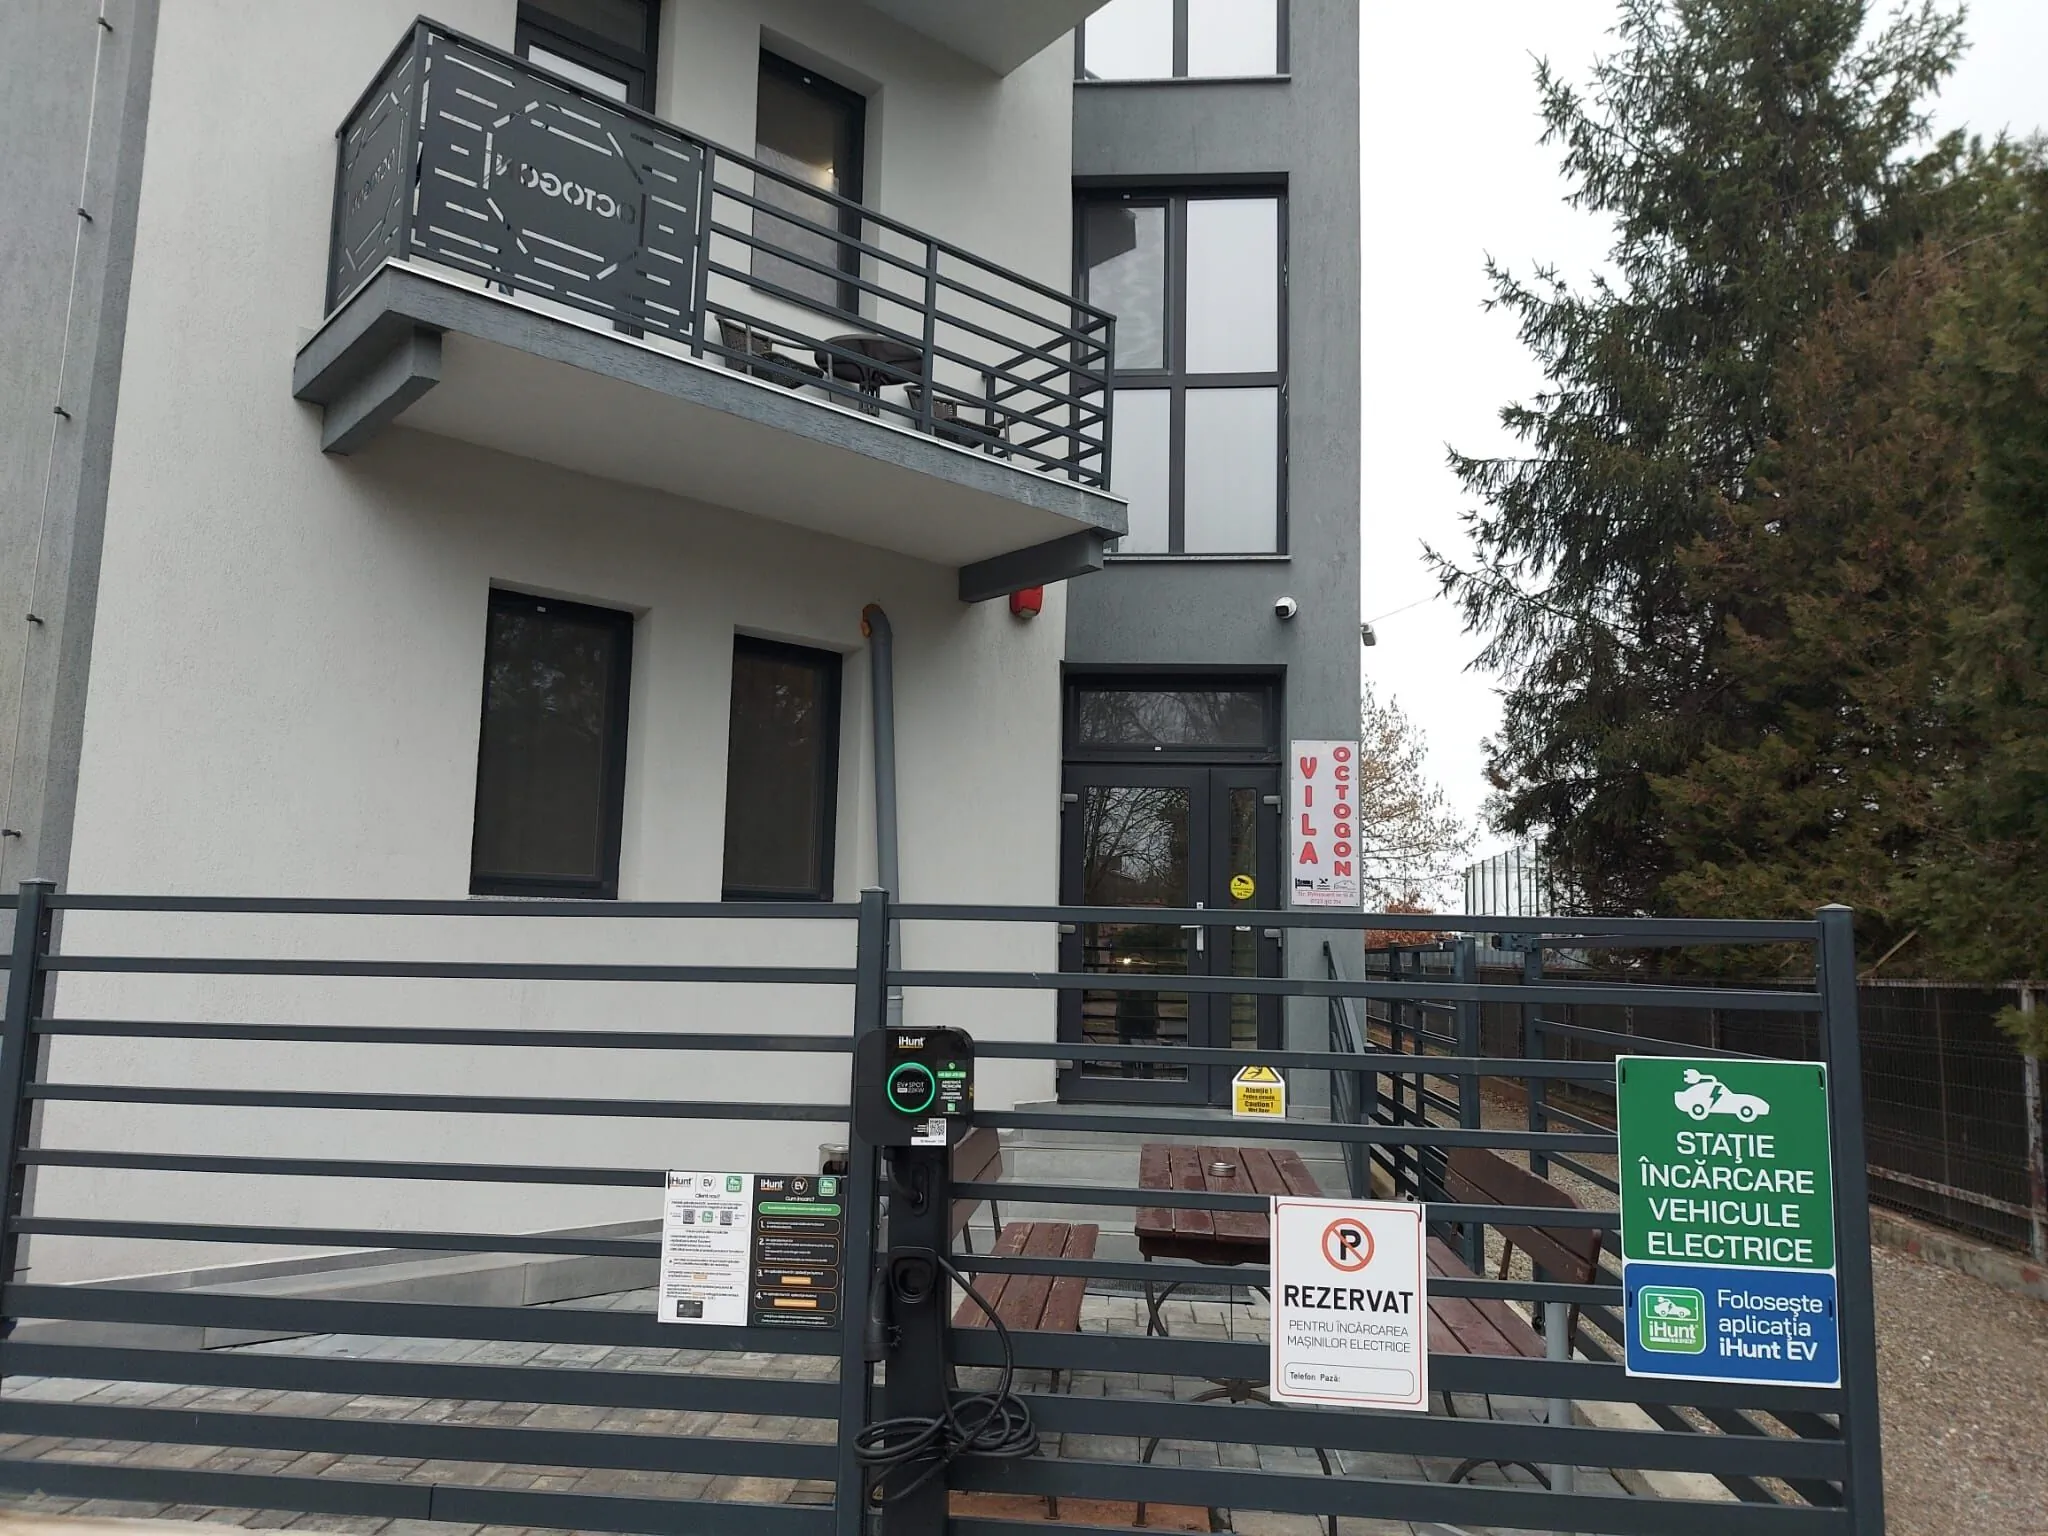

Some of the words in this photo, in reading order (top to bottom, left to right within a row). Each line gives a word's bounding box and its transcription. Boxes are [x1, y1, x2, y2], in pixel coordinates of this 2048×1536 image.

[1300, 757, 1318, 865] VILA
[1333, 746, 1351, 877] OCTOGON
[898, 1035, 924, 1047] iHunt
[670, 1176, 692, 1185] iHunt
[703, 1179, 713, 1187] EV
[760, 1179, 784, 1189] iHunt
[794, 1181, 804, 1190] EV
[1638, 1155, 1815, 1194] ÎNCĂRCARE
[1648, 1197, 1800, 1228] VEHICULE
[1647, 1231, 1813, 1263] ELECTRICE
[1284, 1284, 1413, 1314] REZERVAT
[1289, 1319, 1334, 1333] PENTRU
[1649, 1320, 1696, 1339] iHunt
[1350, 1338, 1411, 1353] ELECTRICE
[1719, 1336, 1782, 1360] iHunt
[1786, 1341, 1819, 1361] EV
[1289, 1371, 1316, 1381] Telefon
